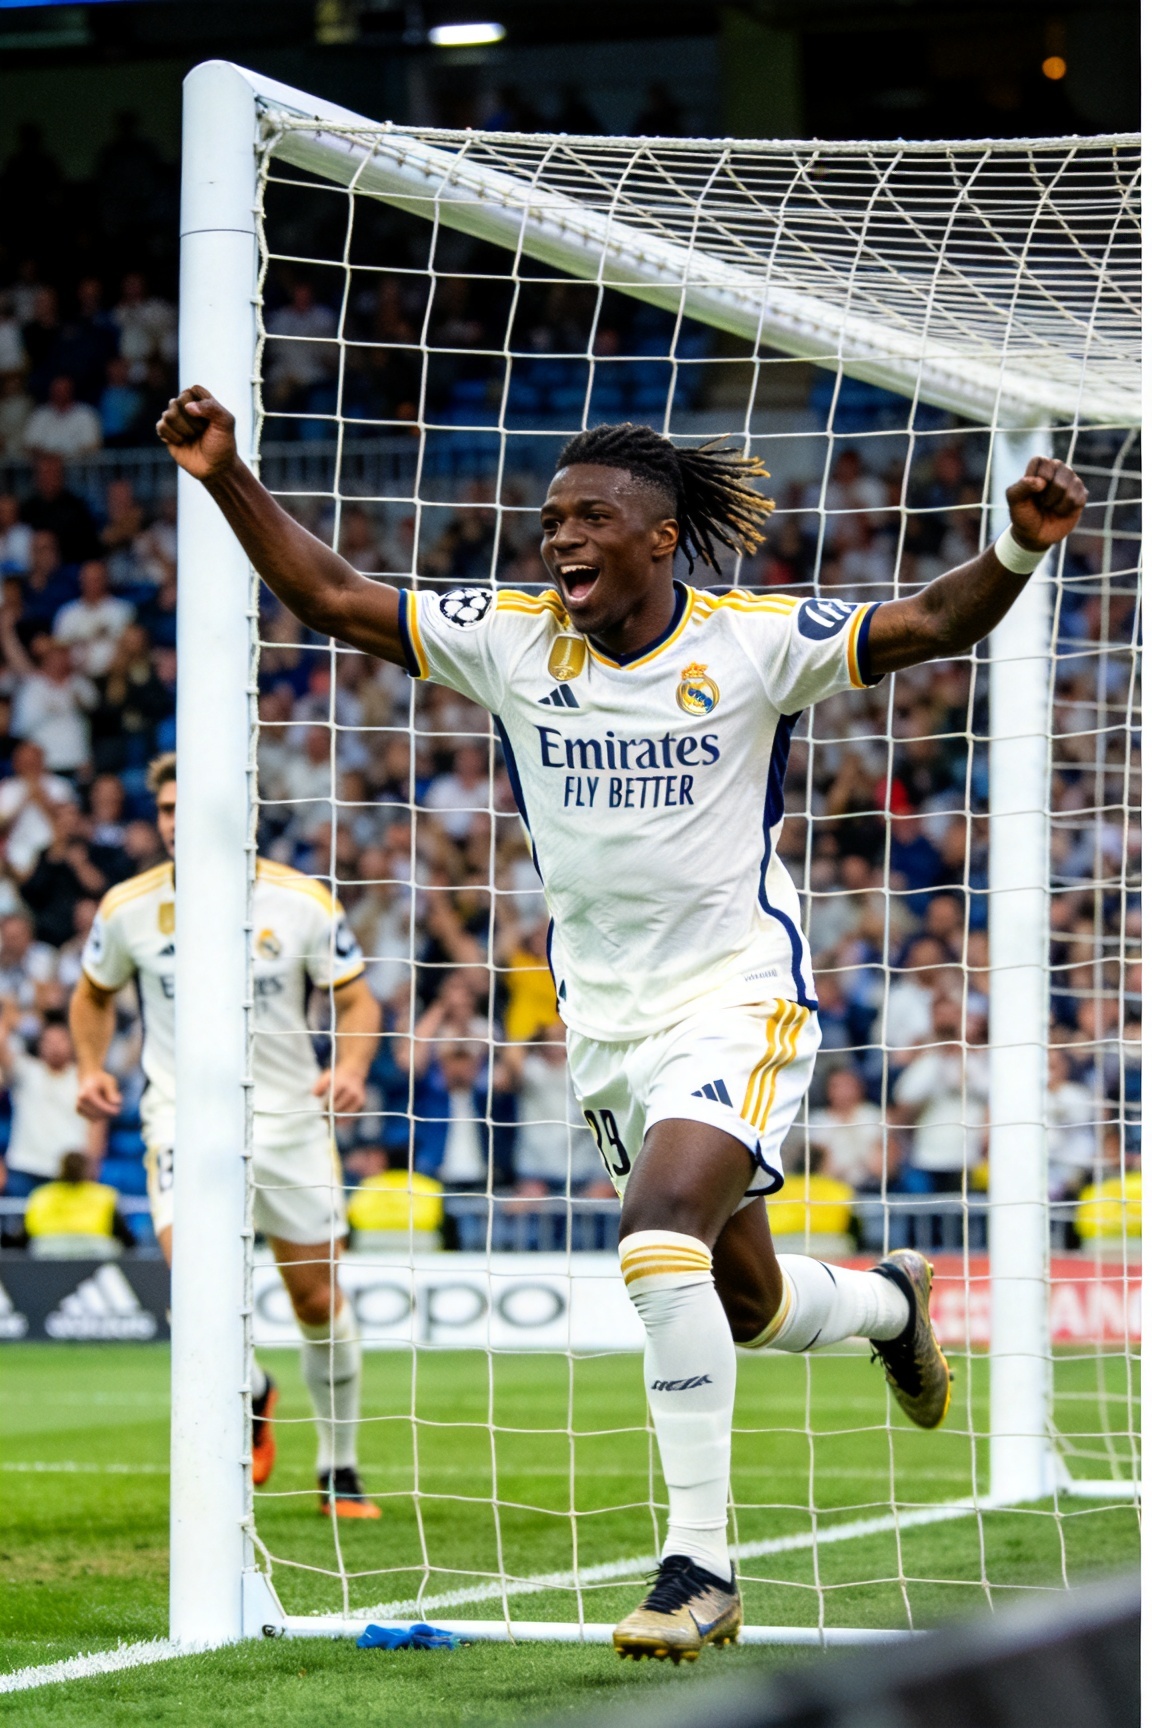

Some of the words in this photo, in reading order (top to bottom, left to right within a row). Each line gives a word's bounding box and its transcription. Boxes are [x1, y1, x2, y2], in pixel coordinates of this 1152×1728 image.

[533, 725, 720, 770] Emirates
[564, 776, 600, 808] FLY
[609, 774, 694, 809] BETTER
